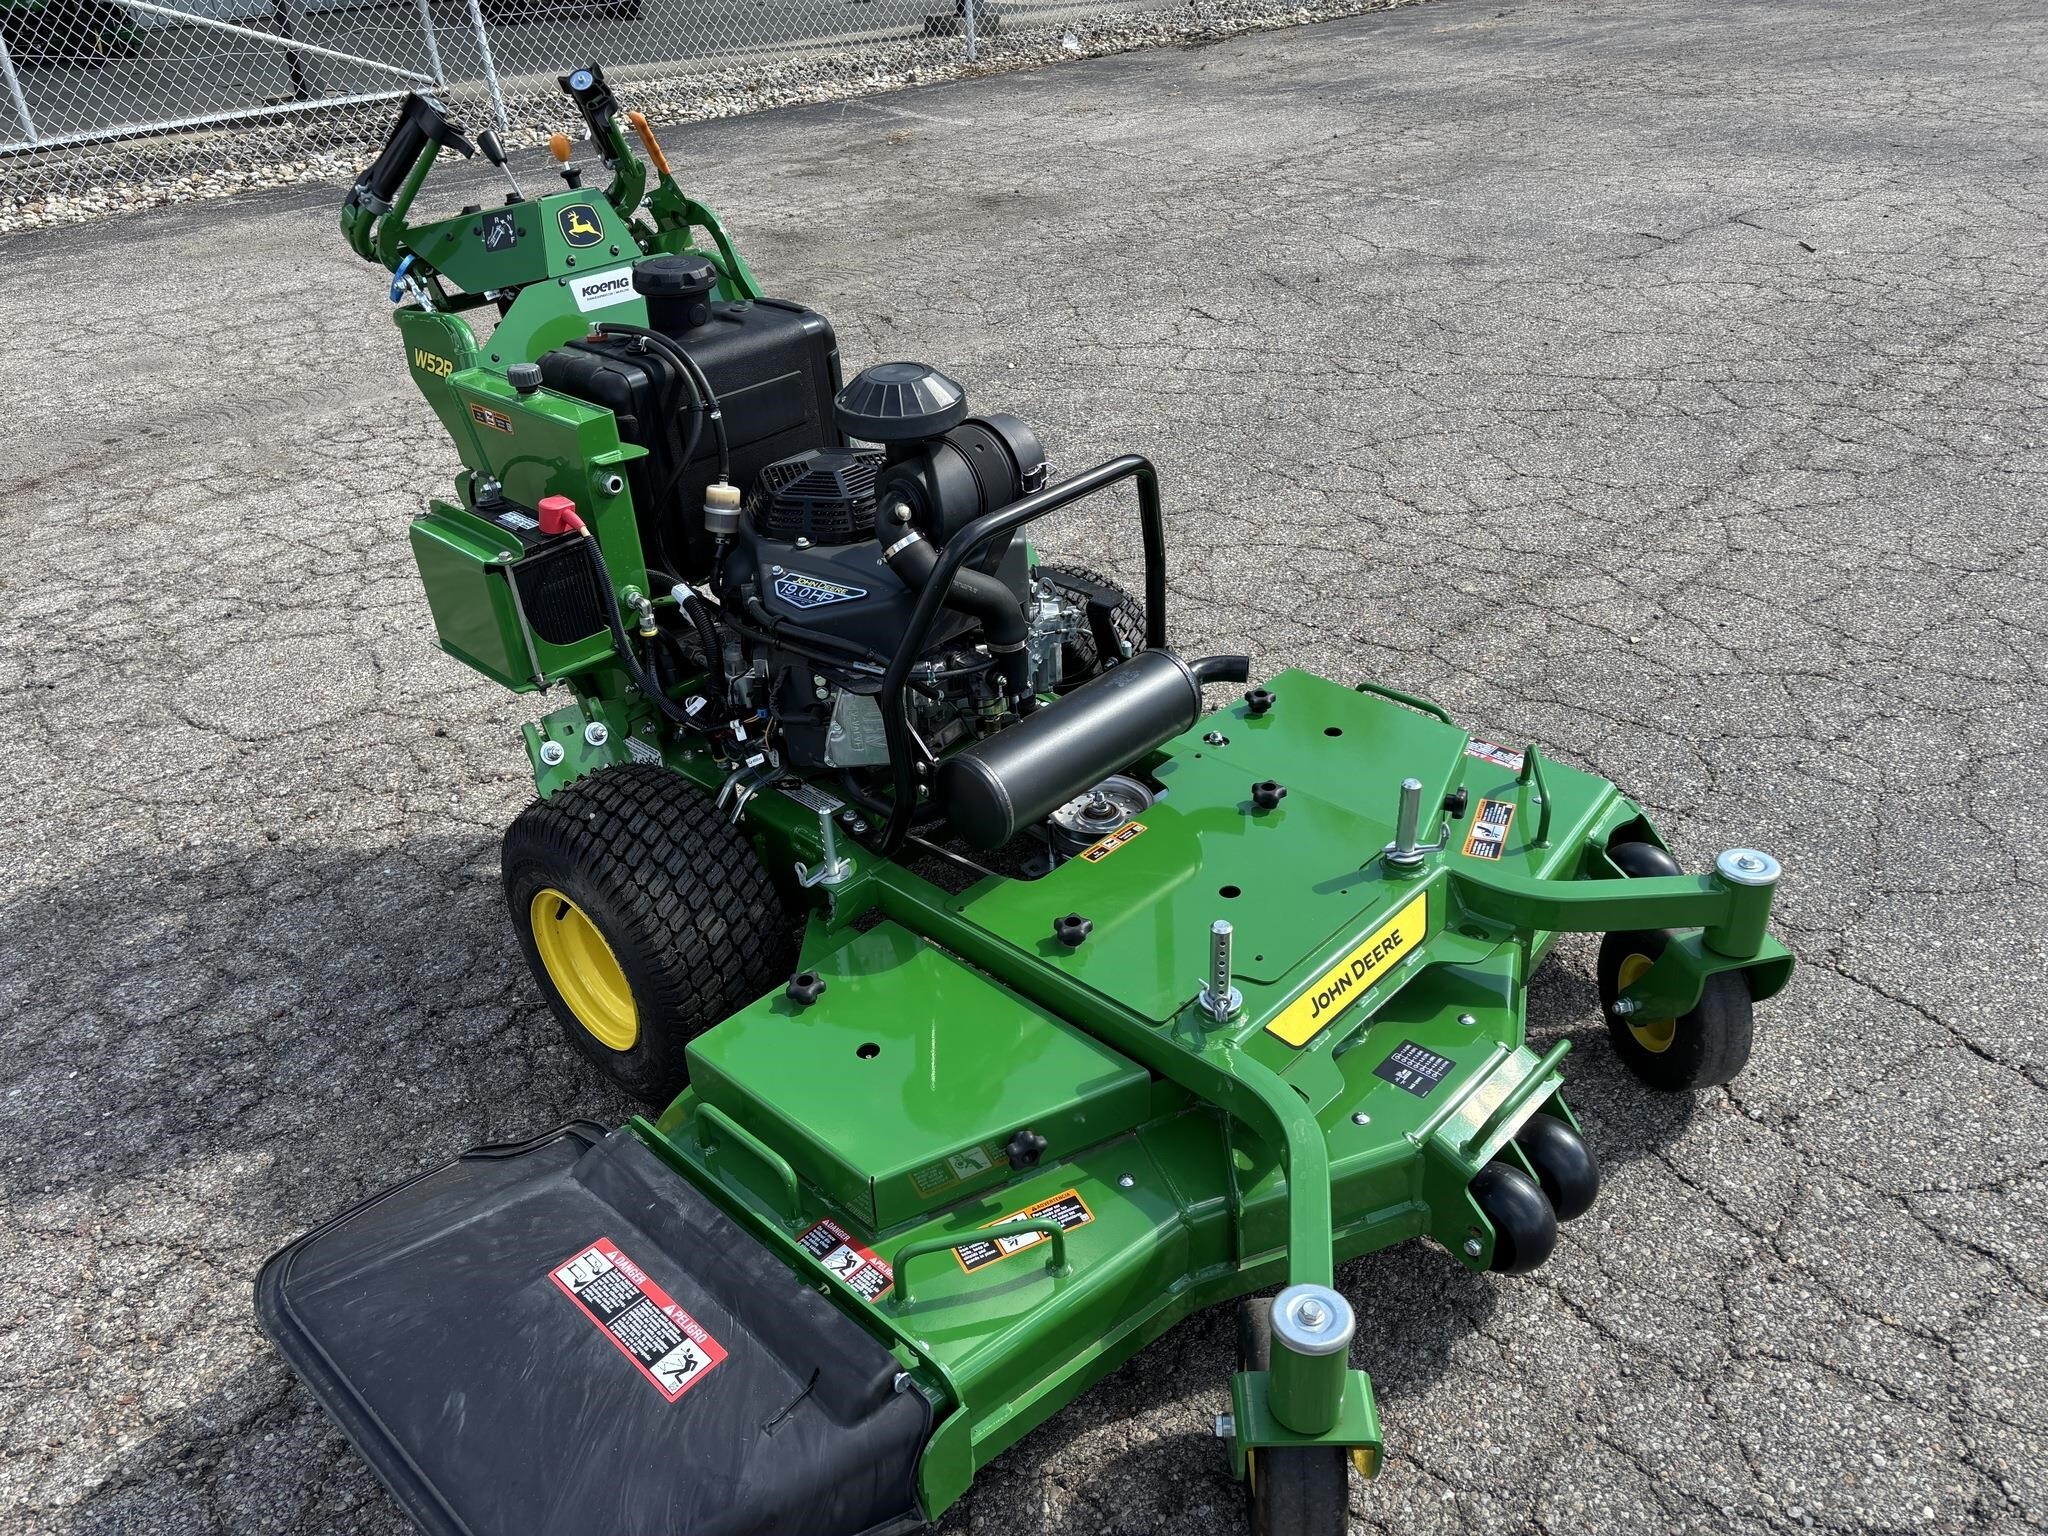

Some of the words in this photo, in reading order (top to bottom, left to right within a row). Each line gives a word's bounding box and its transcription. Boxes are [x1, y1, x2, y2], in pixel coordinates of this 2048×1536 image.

[494, 216, 500, 224] R
[506, 213, 513, 221] N
[510, 236, 516, 244] F
[414, 347, 454, 378] W52R
[779, 582, 809, 598] 19.0
[808, 589, 835, 602] HP
[792, 577, 818, 588] JOHN
[817, 581, 849, 596] DEERE
[1310, 972, 1353, 1019] JOHN
[1350, 928, 1404, 981] DEERE
[1037, 1192, 1071, 1209] ADVERTENCIA
[827, 1220, 851, 1242] DANGER
[614, 1256, 647, 1285] DANGER
[875, 1259, 893, 1279] PELIG
[672, 1309, 709, 1344] PELIGRO
